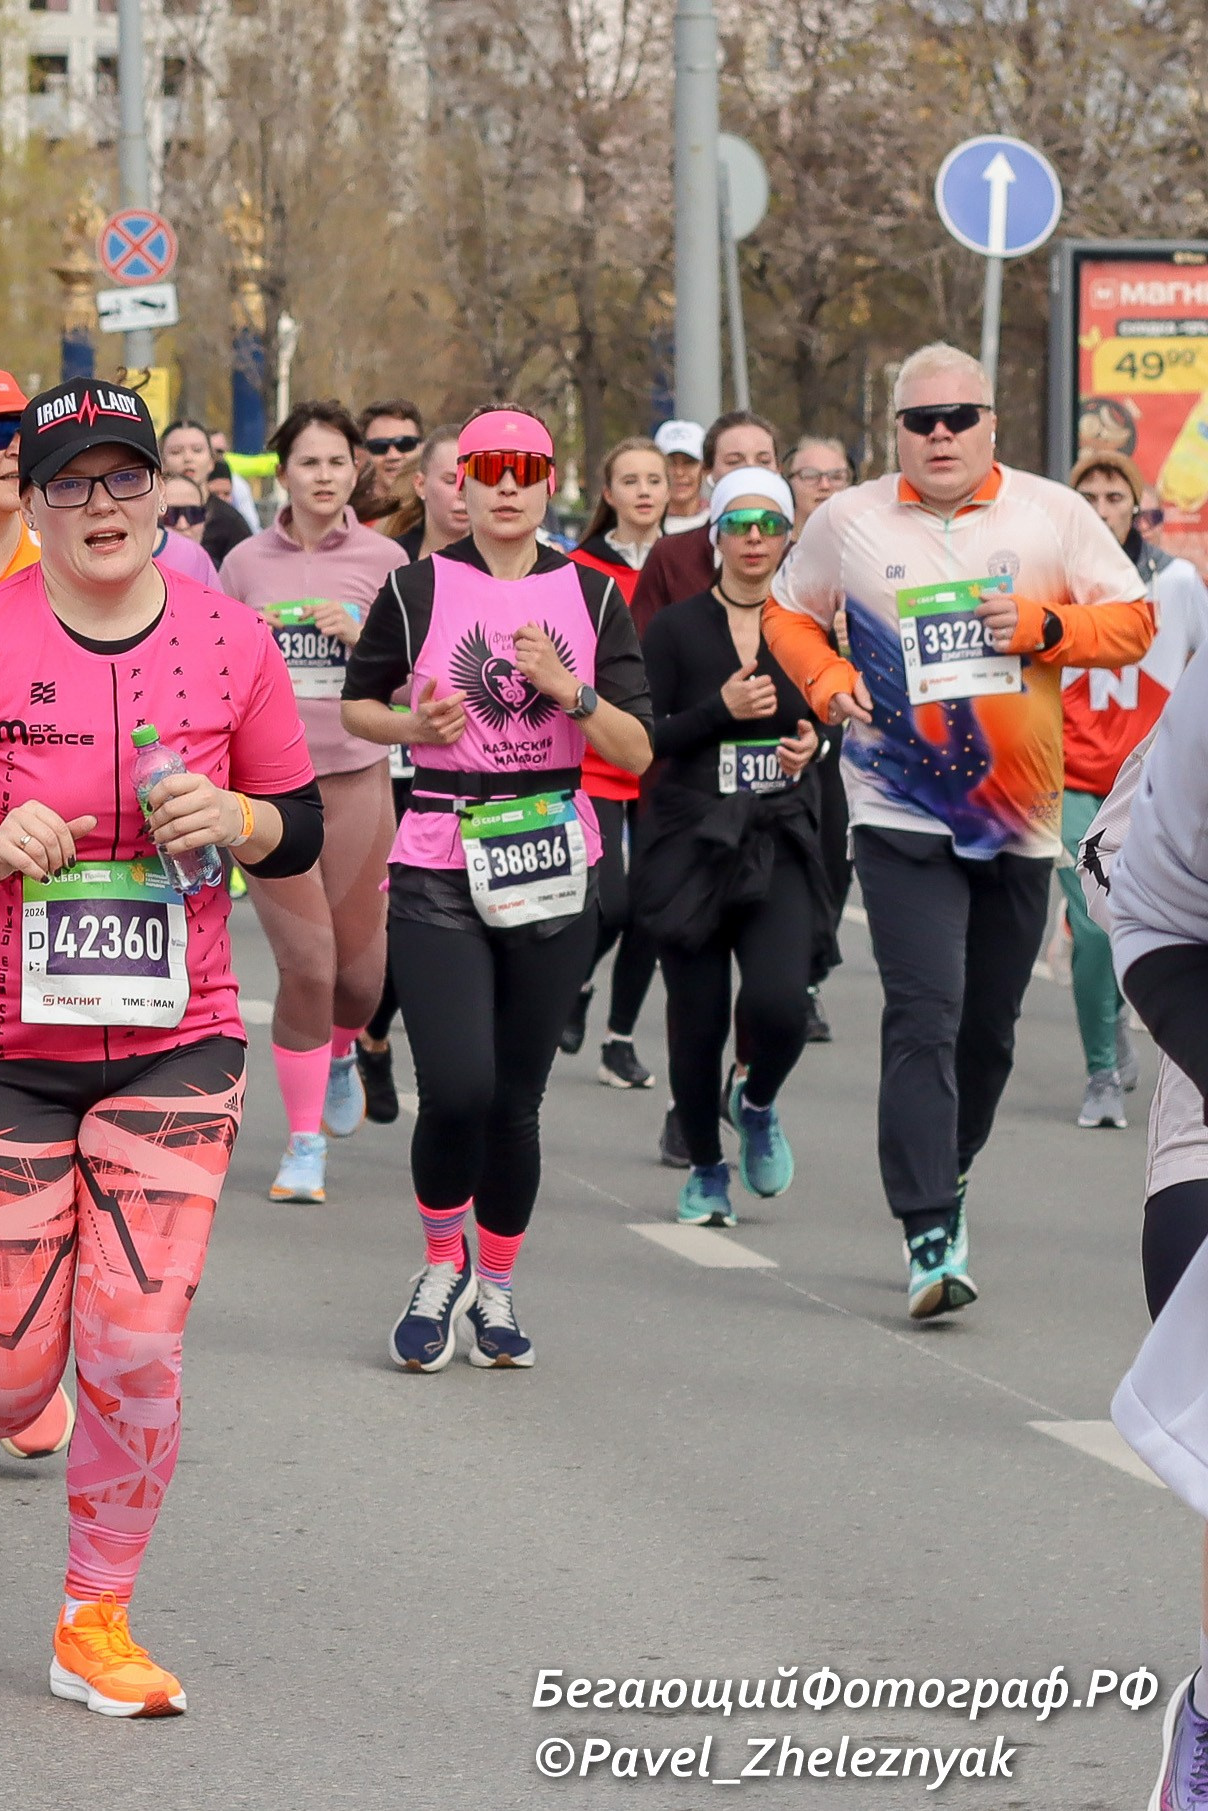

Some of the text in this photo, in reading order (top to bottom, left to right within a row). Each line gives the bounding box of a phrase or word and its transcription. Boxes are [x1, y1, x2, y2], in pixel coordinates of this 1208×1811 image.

[36, 389, 138, 427] IRON LADY
[278, 632, 341, 659] 33084
[904, 638, 915, 650] D
[723, 762, 733, 775] D
[474, 858, 486, 871] C
[491, 836, 566, 878] 38836
[25, 908, 45, 918] 2026
[29, 931, 45, 950] D
[54, 915, 164, 961] 42360
[57, 996, 102, 1006] МАГНИТ
